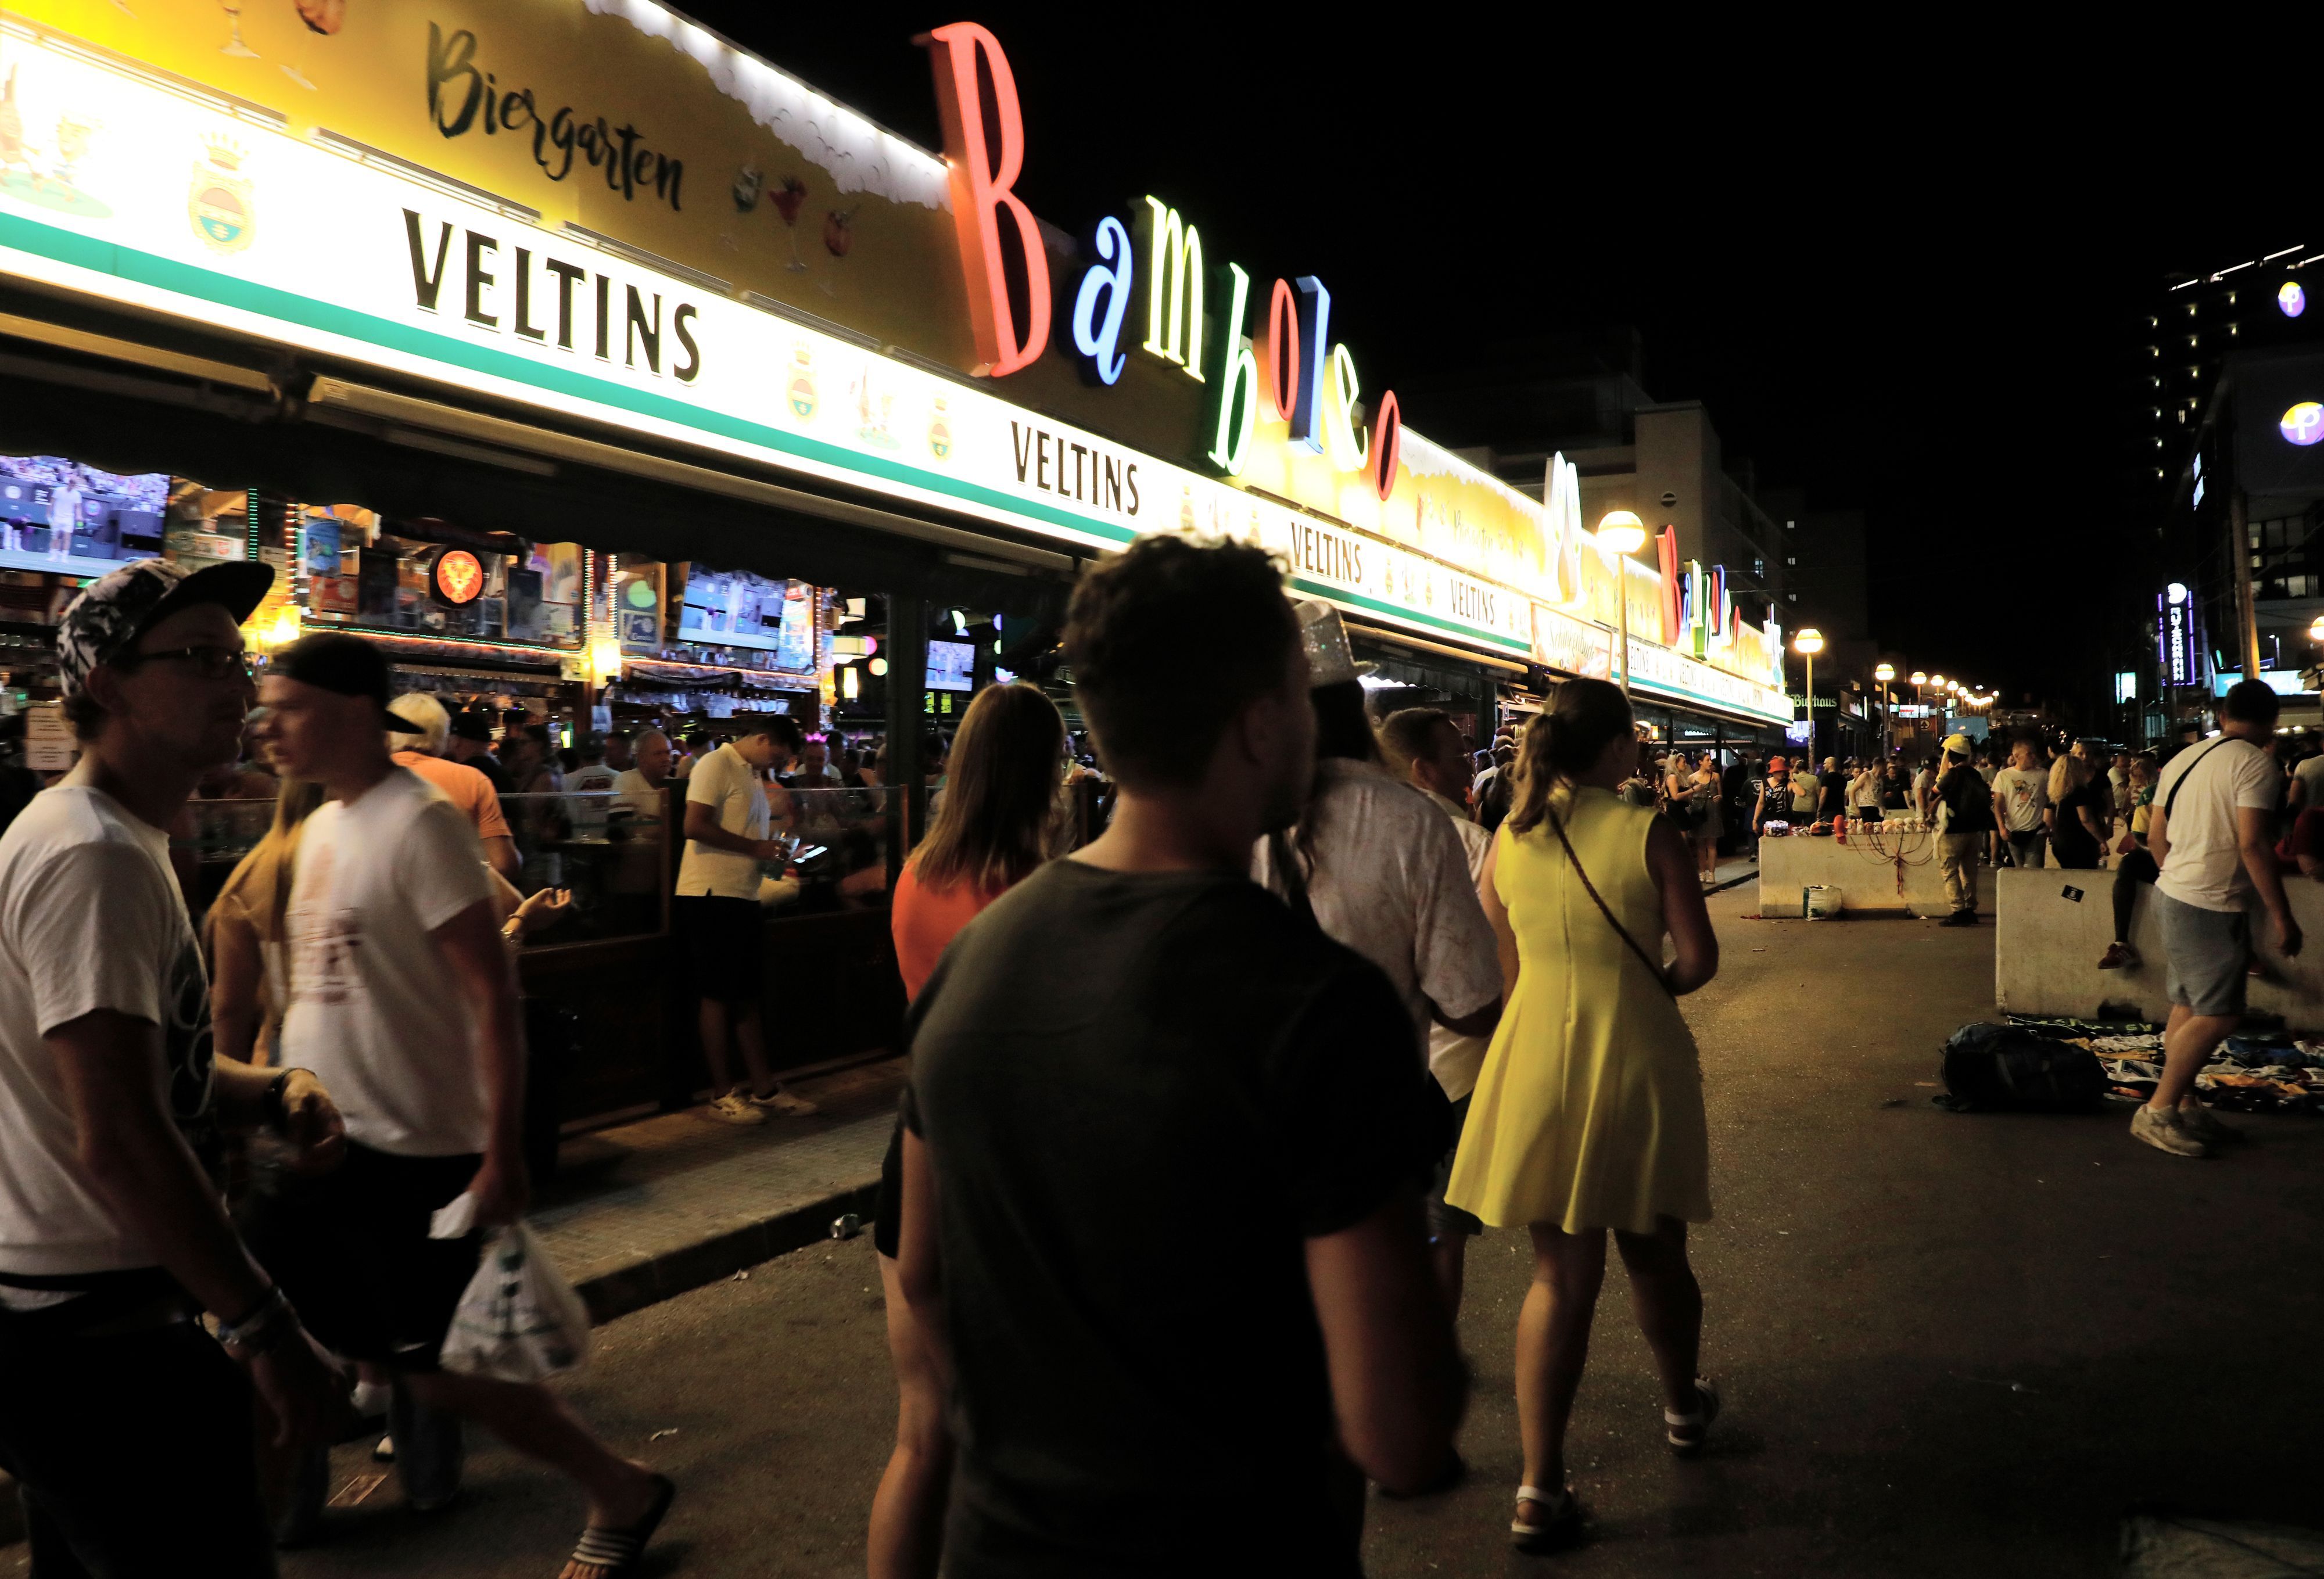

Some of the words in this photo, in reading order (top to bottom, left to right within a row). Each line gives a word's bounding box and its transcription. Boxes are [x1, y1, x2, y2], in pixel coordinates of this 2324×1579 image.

[427, 21, 684, 211] Biergarten
[402, 208, 701, 385] VELTINS
[912, 21, 1401, 502] Bamboleo
[1010, 421, 1140, 516] VELTINS
[1291, 522, 1362, 583] VELTINS
[1451, 579, 1494, 625] VELTINS
[1630, 645, 1649, 673] ELTINS
